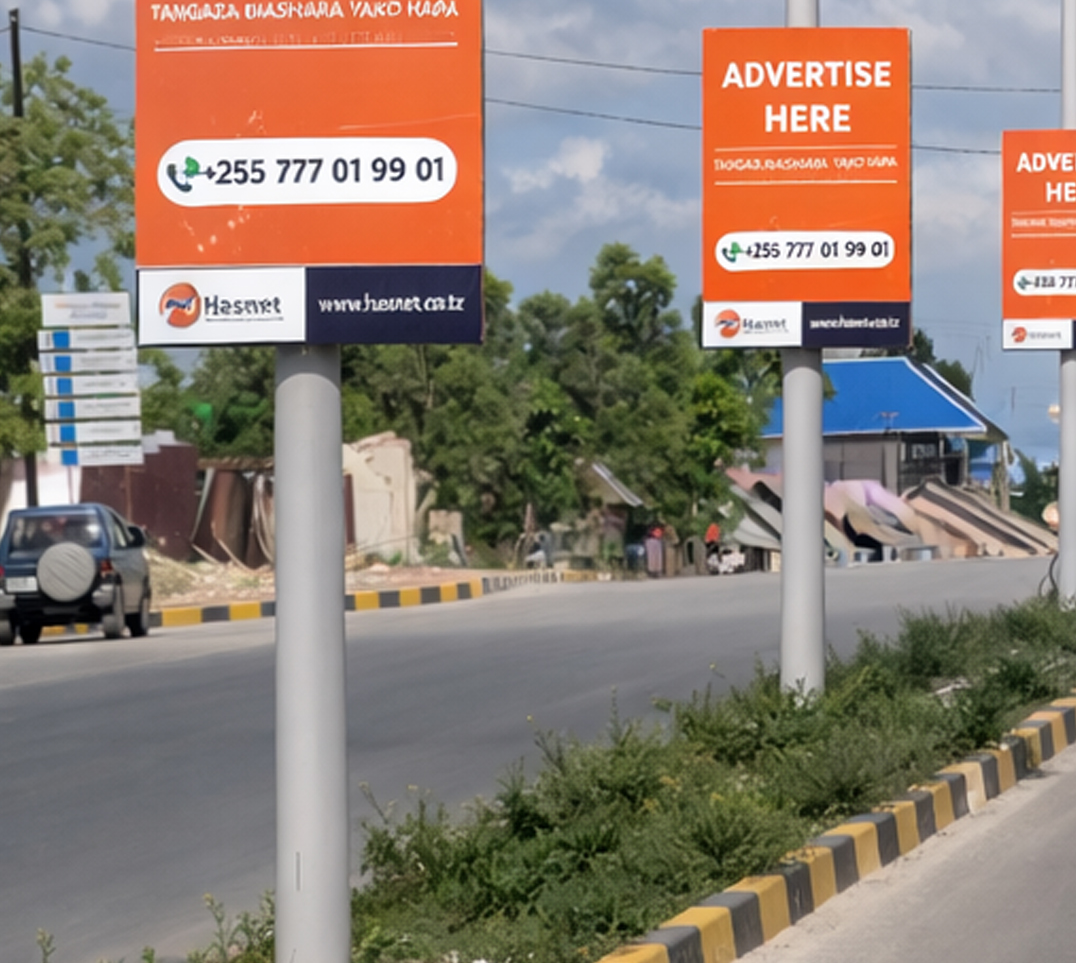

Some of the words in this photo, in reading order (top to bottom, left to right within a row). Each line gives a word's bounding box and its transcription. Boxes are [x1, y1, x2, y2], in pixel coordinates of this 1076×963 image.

[721, 61, 892, 89] ADVERTISE
[765, 104, 852, 133] HERE
[276, 158, 324, 185] 777
[332, 157, 361, 184] 01
[371, 157, 406, 183] 99
[416, 156, 444, 183] 01
[786, 241, 815, 259] 777
[820, 241, 839, 258] 01
[871, 240, 889, 257] 01
